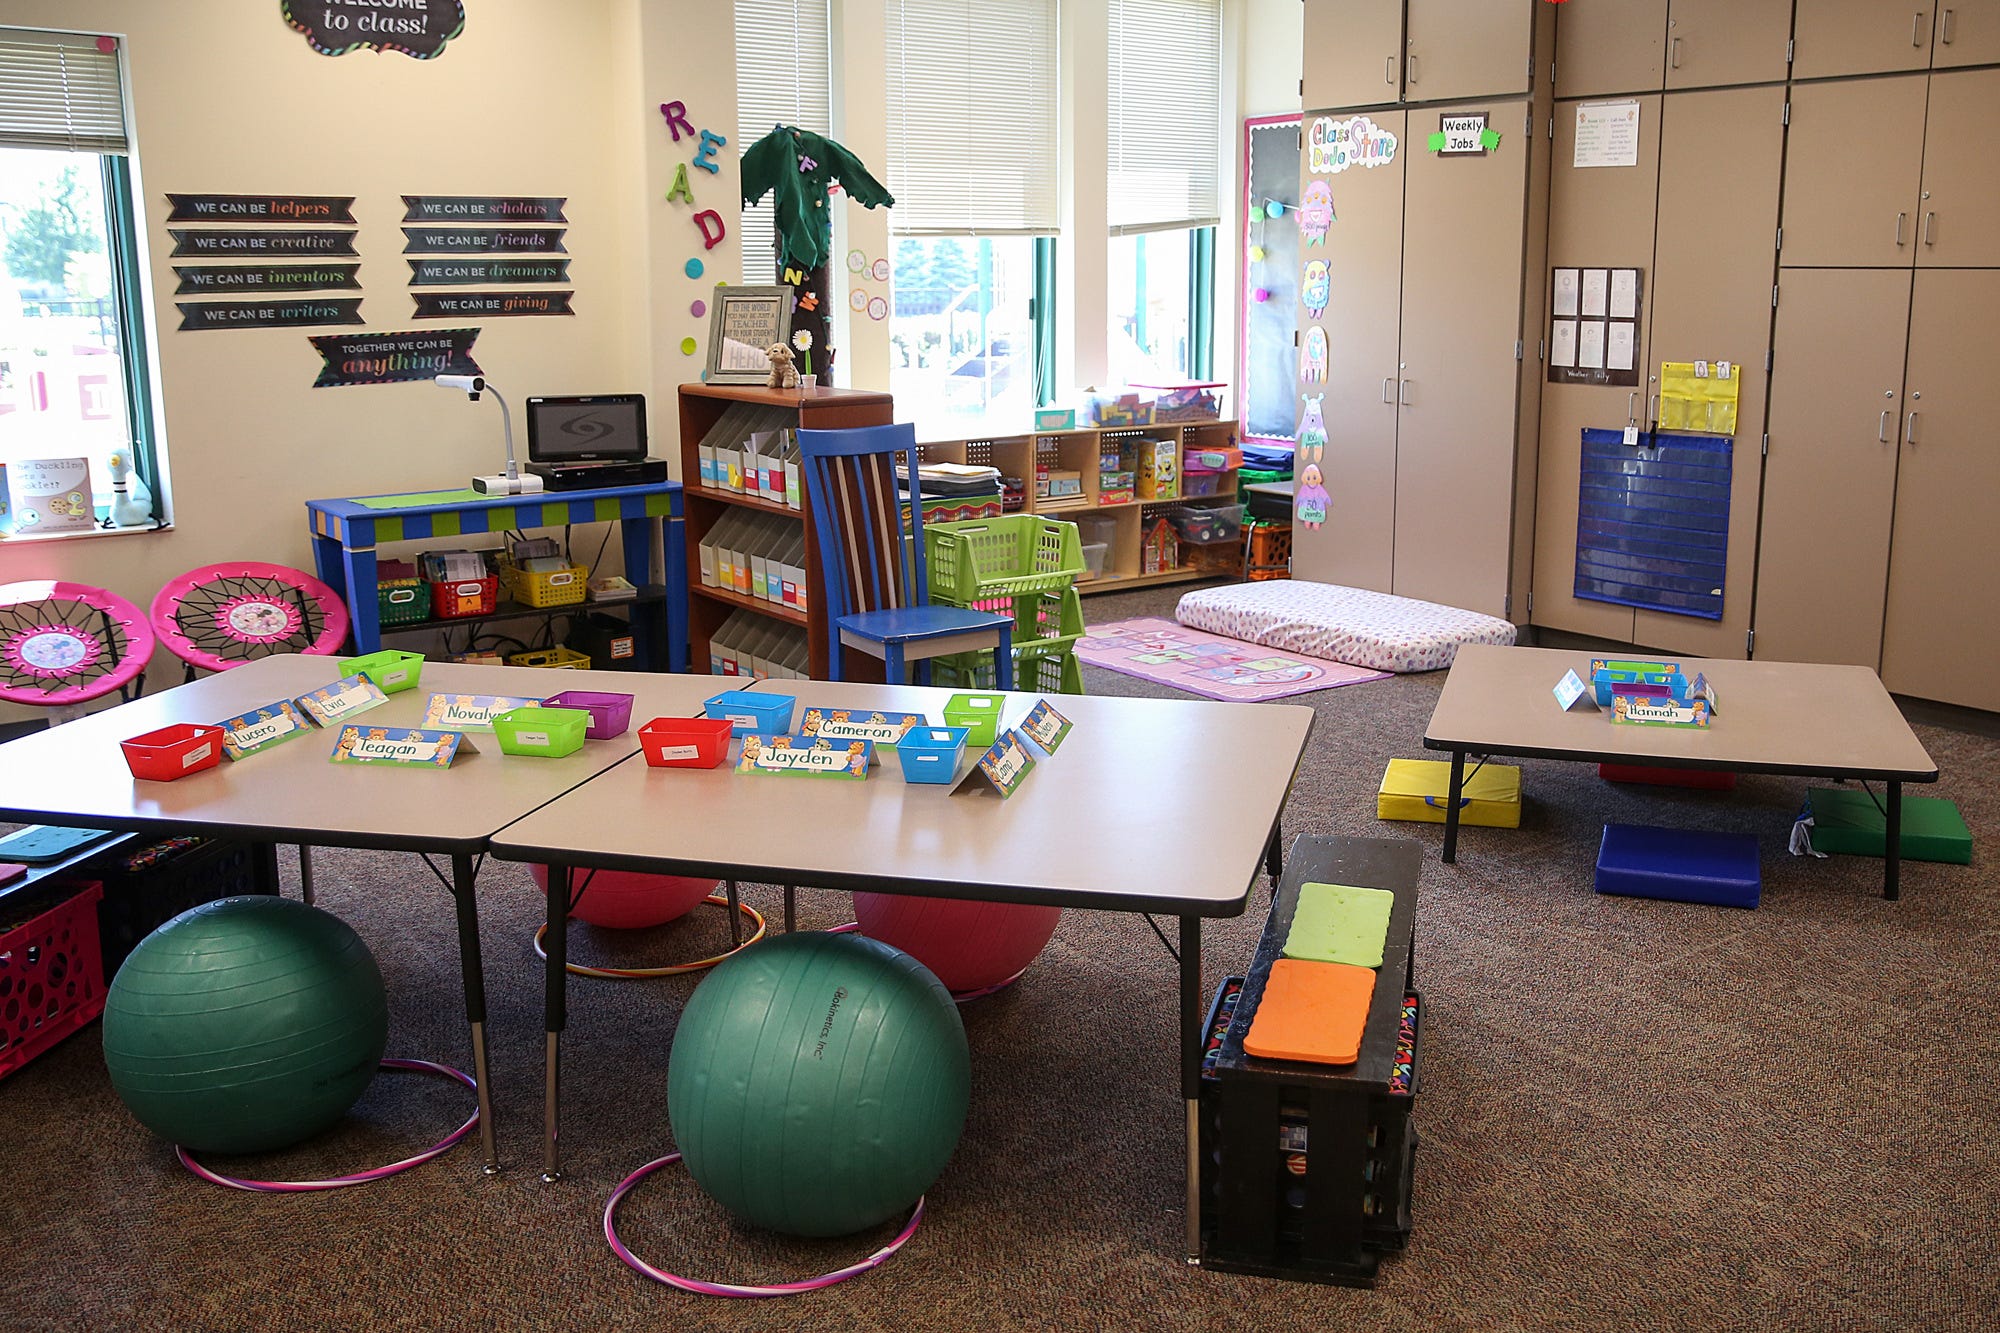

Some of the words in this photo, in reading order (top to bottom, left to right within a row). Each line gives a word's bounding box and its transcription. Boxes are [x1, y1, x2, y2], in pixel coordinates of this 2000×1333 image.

[323, 9, 349, 30] to
[357, 11, 428, 35] class!
[1444, 119, 1483, 133] Weekly
[1313, 123, 1350, 145] Class
[1350, 121, 1394, 159] Store
[1450, 138, 1474, 149] Jobs
[195, 203, 217, 213] WE
[220, 203, 247, 214] CAN
[250, 204, 266, 214] BE
[270, 201, 330, 218] helpers
[422, 204, 442, 214] WE
[444, 204, 468, 214] CAN
[471, 204, 485, 214] BE
[489, 202, 548, 215] scholars
[195, 238, 217, 248] WE
[220, 238, 247, 248] CAN
[250, 238, 267, 248] BE
[270, 235, 335, 249] creative
[425, 236, 445, 246] WE
[447, 236, 470, 246] CAN
[473, 236, 488, 246] BE
[491, 234, 546, 248] friends
[192, 275, 213, 285] WE
[216, 274, 244, 284] CAN
[247, 273, 263, 283] BE
[268, 270, 345, 284] inventors
[423, 267, 443, 277] WE
[445, 267, 469, 277] CAN
[471, 267, 485, 276] BE
[489, 264, 557, 277] dreamers
[439, 300, 458, 310] WE
[460, 300, 484, 310] CAN
[486, 299, 500, 309] BE
[504, 296, 549, 312] giving
[733, 303, 739, 312] TO
[741, 303, 751, 312] THE
[752, 303, 771, 312] WORLD
[205, 310, 226, 320] WE
[229, 310, 256, 320] CAN
[259, 309, 275, 319] BE
[280, 304, 339, 318] writers
[732, 320, 768, 328] TEACHER
[342, 343, 396, 354] TOGETHER
[397, 341, 414, 351] WE
[415, 341, 438, 350] CAN
[439, 340, 453, 348] BE
[342, 350, 453, 376] anything!
[35, 461, 84, 471] Duckling
[447, 705, 503, 724] Novaly
[1630, 704, 1679, 718] Hannah
[233, 724, 276, 743] Lucero
[822, 719, 892, 738] Cameron
[359, 737, 417, 759] Teagan
[765, 746, 833, 767] Jayden
